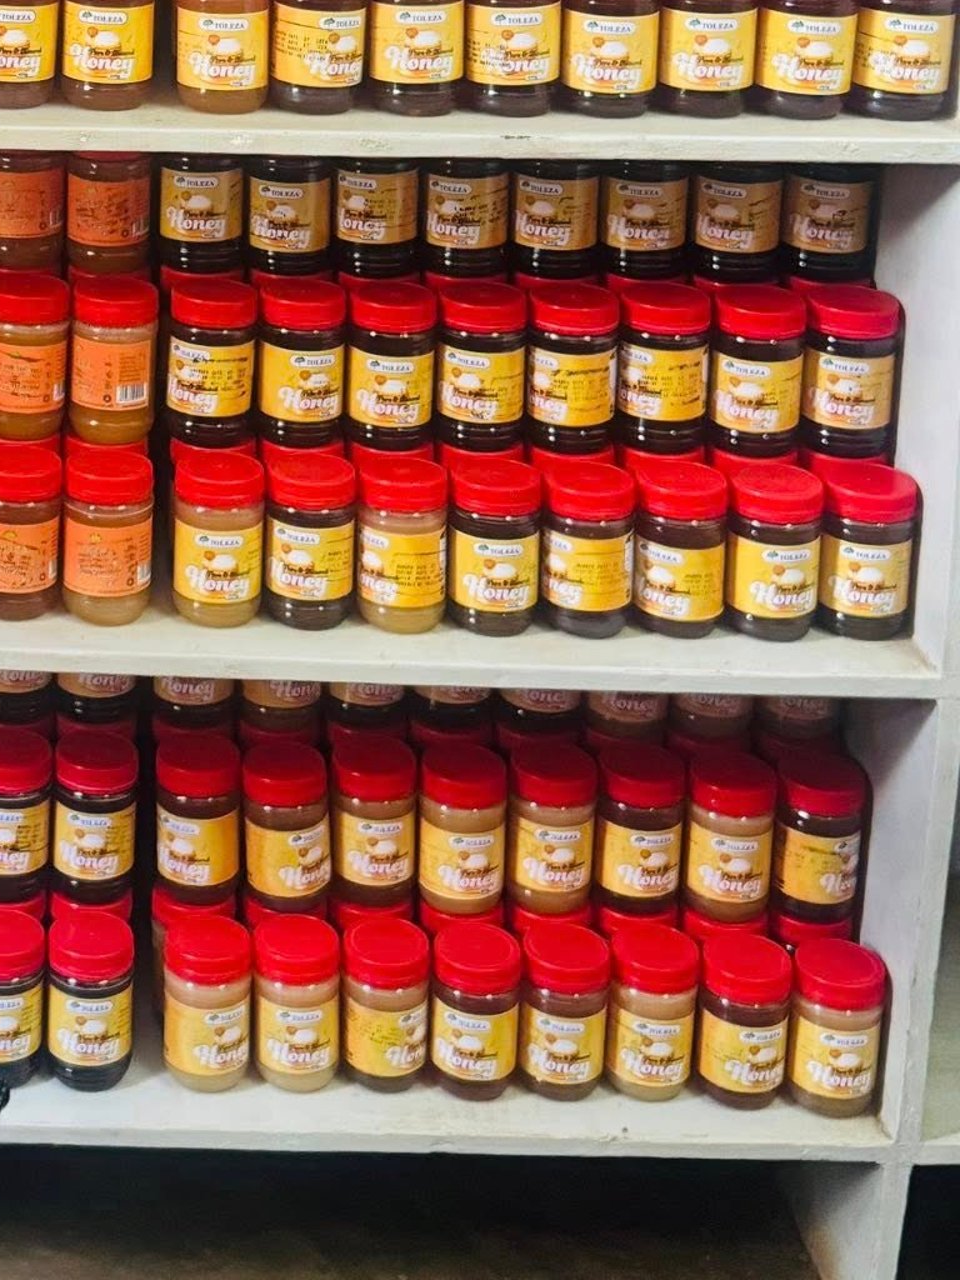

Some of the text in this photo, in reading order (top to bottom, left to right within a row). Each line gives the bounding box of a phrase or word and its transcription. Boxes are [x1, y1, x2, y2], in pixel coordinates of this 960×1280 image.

[70, 44, 135, 79] Honey
[189, 52, 256, 87] Honey
[386, 47, 454, 81] Honey
[573, 54, 643, 90] Honey
[673, 53, 744, 87] Honey
[773, 55, 845, 90] Honey
[166, 208, 226, 239] Honey
[253, 216, 308, 248] Honey
[427, 212, 480, 245] Honey
[516, 210, 570, 243] Honey
[611, 215, 669, 247] Honey
[698, 217, 760, 251] Honey
